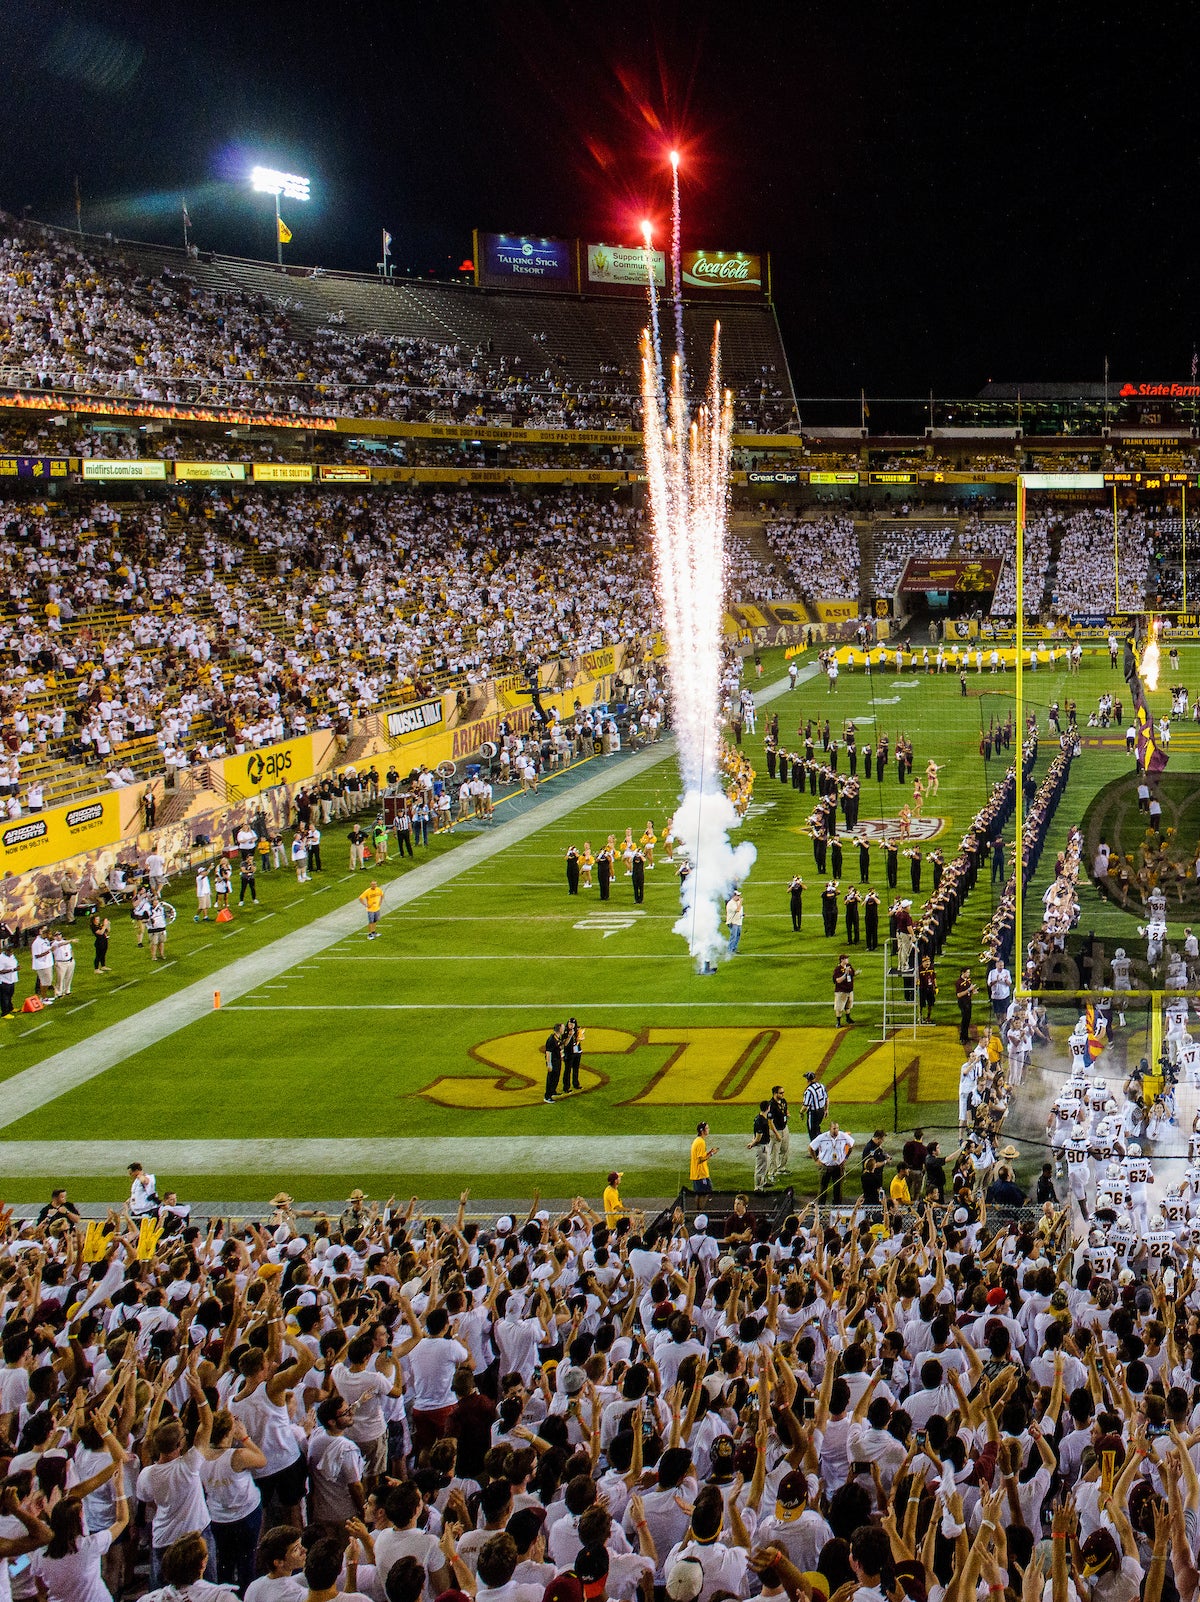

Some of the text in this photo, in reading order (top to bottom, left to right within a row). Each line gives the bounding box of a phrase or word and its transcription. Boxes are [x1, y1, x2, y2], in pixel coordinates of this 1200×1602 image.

[499, 254, 558, 268] TALKING STICK
[613, 252, 644, 262] Support
[512, 264, 545, 275] RESORT
[691, 258, 751, 279] Coca-Cola
[1139, 383, 1200, 396] State Farm
[491, 430, 528, 439] CHAMPIONS
[1122, 438, 1179, 446] FRANK KUSH FIELD
[85, 463, 143, 476] midfirst.com/asu
[186, 467, 227, 477] American Airlines
[272, 469, 278, 477] BE
[279, 469, 288, 477] THE
[289, 468, 310, 477] SOLUTION
[749, 473, 797, 483] Great Clips
[1135, 473, 1141, 482] 0
[1164, 473, 1170, 482] 0
[825, 608, 851, 618] ASU
[1177, 614, 1198, 624] SUN
[1163, 629, 1194, 637] GEICO
[388, 702, 442, 737] MUSCLE MILK
[452, 715, 500, 760] ARIZONA
[266, 750, 292, 778] aps
[67, 804, 103, 821] ARIZONA
[68, 809, 101, 826] SPORTS
[4, 821, 46, 840] ARIZONA
[70, 827, 80, 835] NOW
[97, 819, 104, 827] FM
[6, 827, 45, 845] SPORTS
[5, 847, 18, 856] NOW
[20, 844, 28, 852] ON
[1152, 931, 1159, 942] 2
[1175, 1014, 1182, 1024] 5
[1184, 1051, 1196, 1063] 17
[1060, 1109, 1078, 1121] 54
[1115, 1123, 1122, 1137] 7
[1129, 1169, 1147, 1183] 63
[1150, 1242, 1171, 1258] 22
[1094, 1258, 1111, 1274] 31
